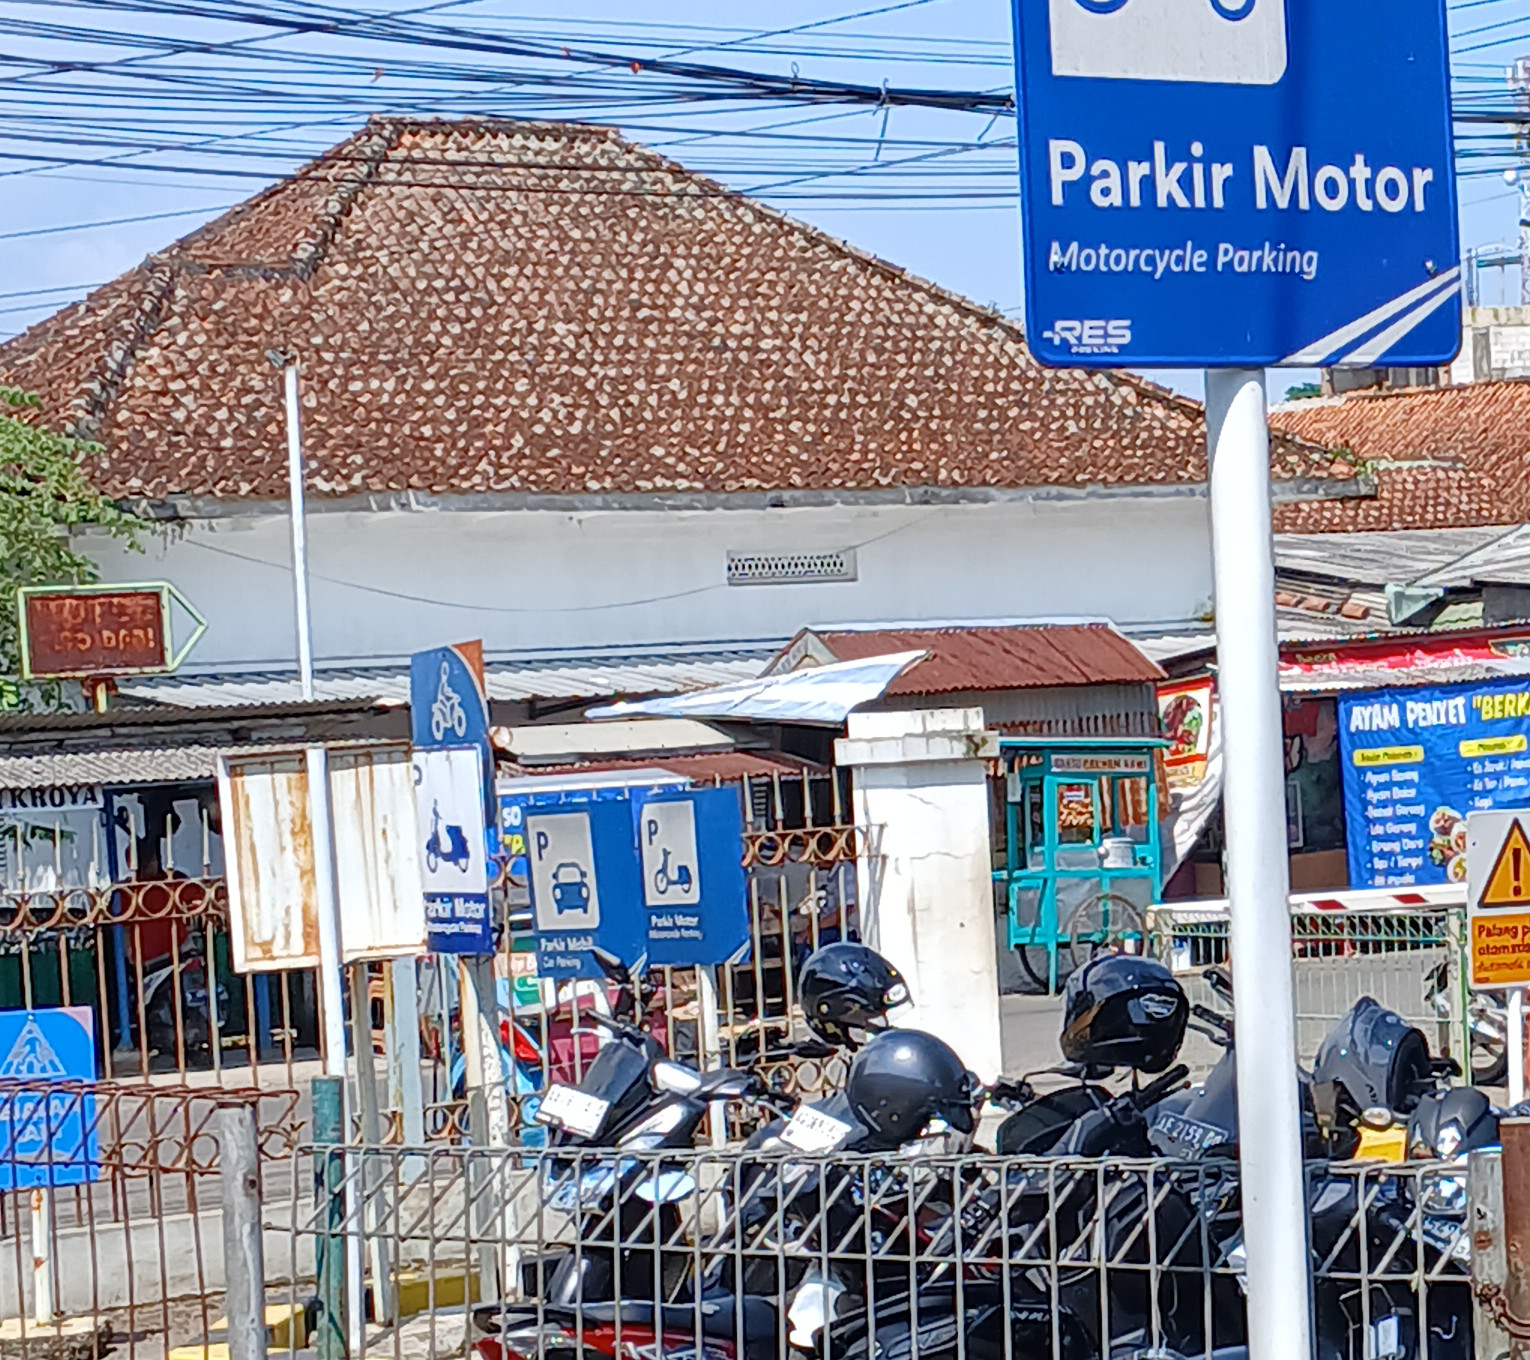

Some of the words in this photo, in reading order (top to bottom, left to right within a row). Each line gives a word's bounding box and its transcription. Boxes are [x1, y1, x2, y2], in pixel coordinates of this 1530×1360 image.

[1049, 139, 1233, 209] Parkir
[1253, 145, 1433, 212] Motor
[1049, 240, 1208, 280] Motorcycle
[1217, 241, 1319, 281] Parking
[1350, 703, 1399, 732] AYAM
[1406, 696, 1466, 728] PENYET
[12, 786, 99, 808] KROYA
[536, 831, 548, 861] P
[648, 819, 658, 846] P
